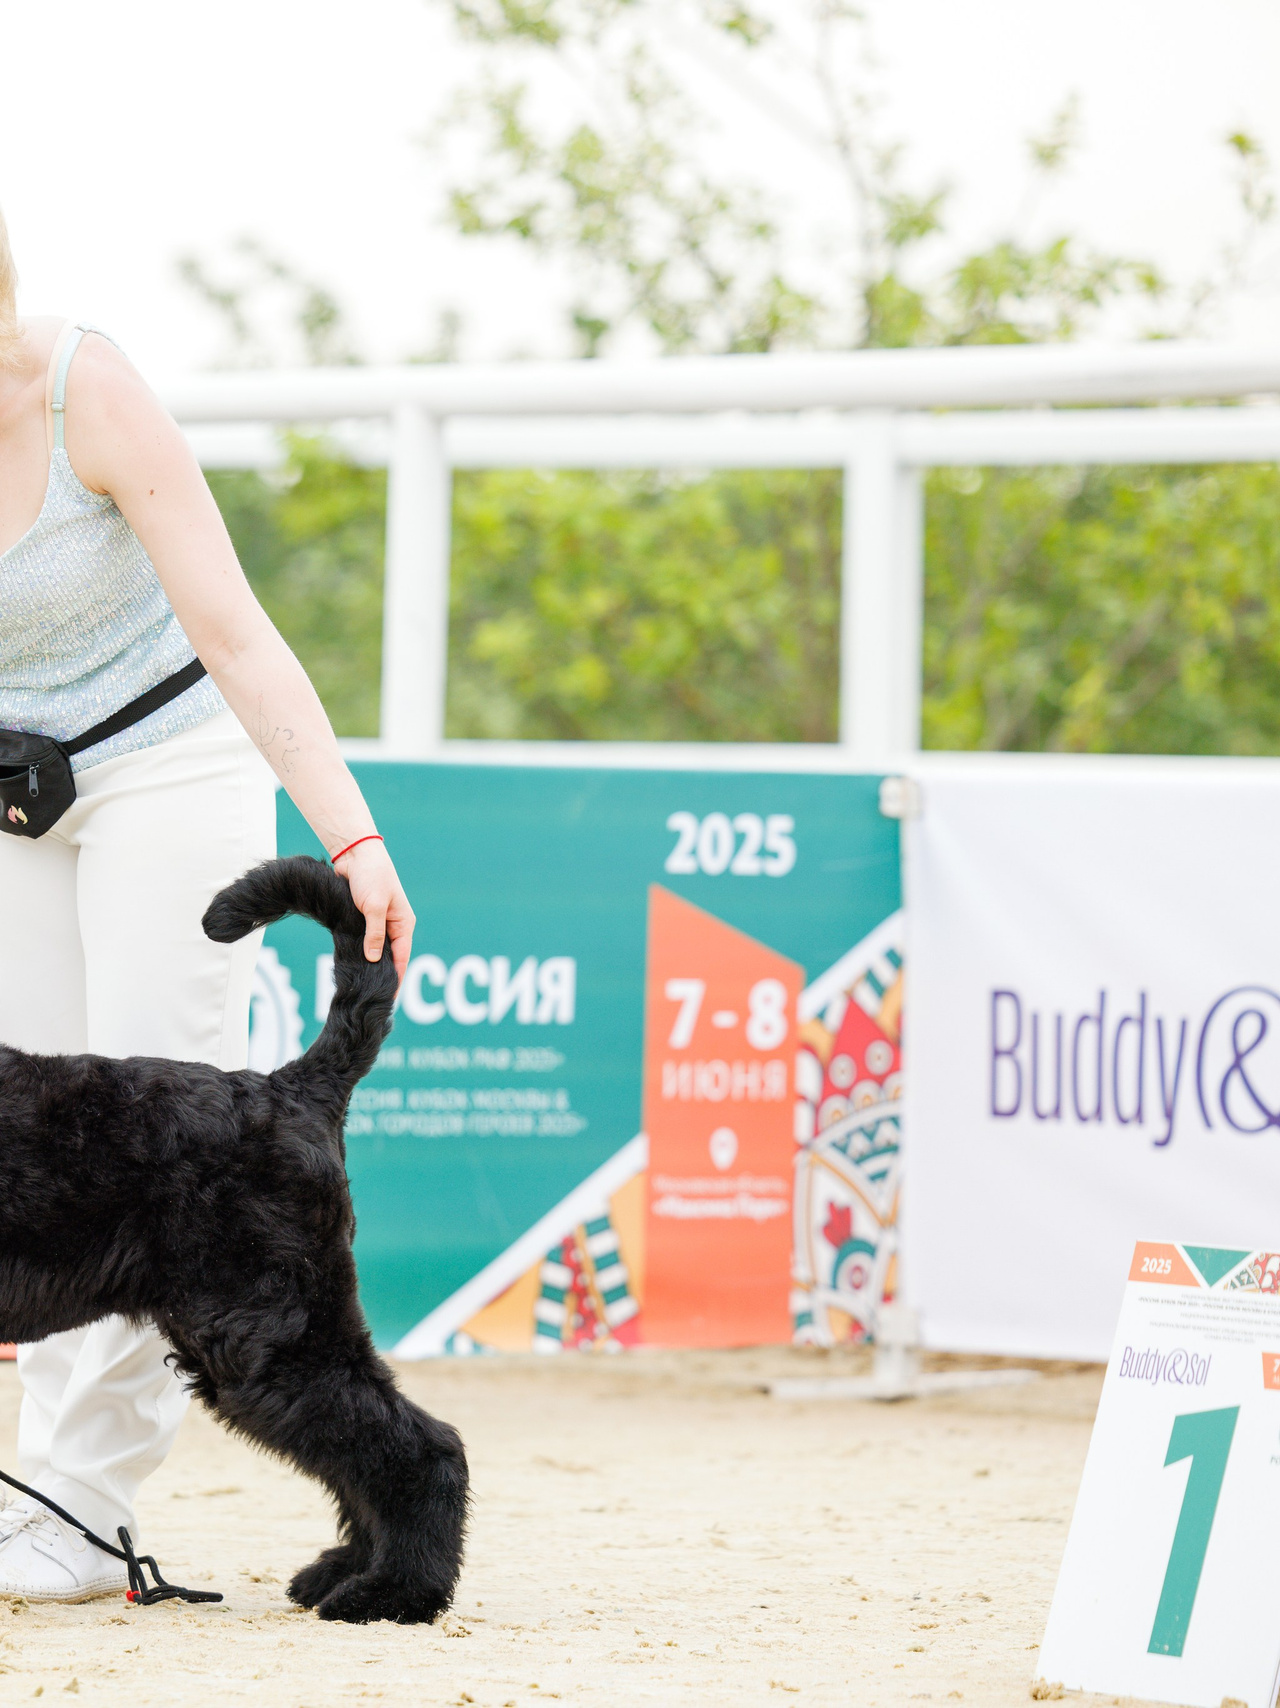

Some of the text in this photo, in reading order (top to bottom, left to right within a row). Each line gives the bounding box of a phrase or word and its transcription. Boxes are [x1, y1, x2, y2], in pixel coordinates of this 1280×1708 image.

[665, 811, 797, 877] 2025
[315, 953, 577, 1025] ССИЯ
[665, 978, 706, 1049] 7
[746, 978, 788, 1050] 8
[662, 1059, 787, 1101] ИЮНЯ
[1141, 1257, 1172, 1274] 2025
[1147, 1405, 1240, 1657] 1
